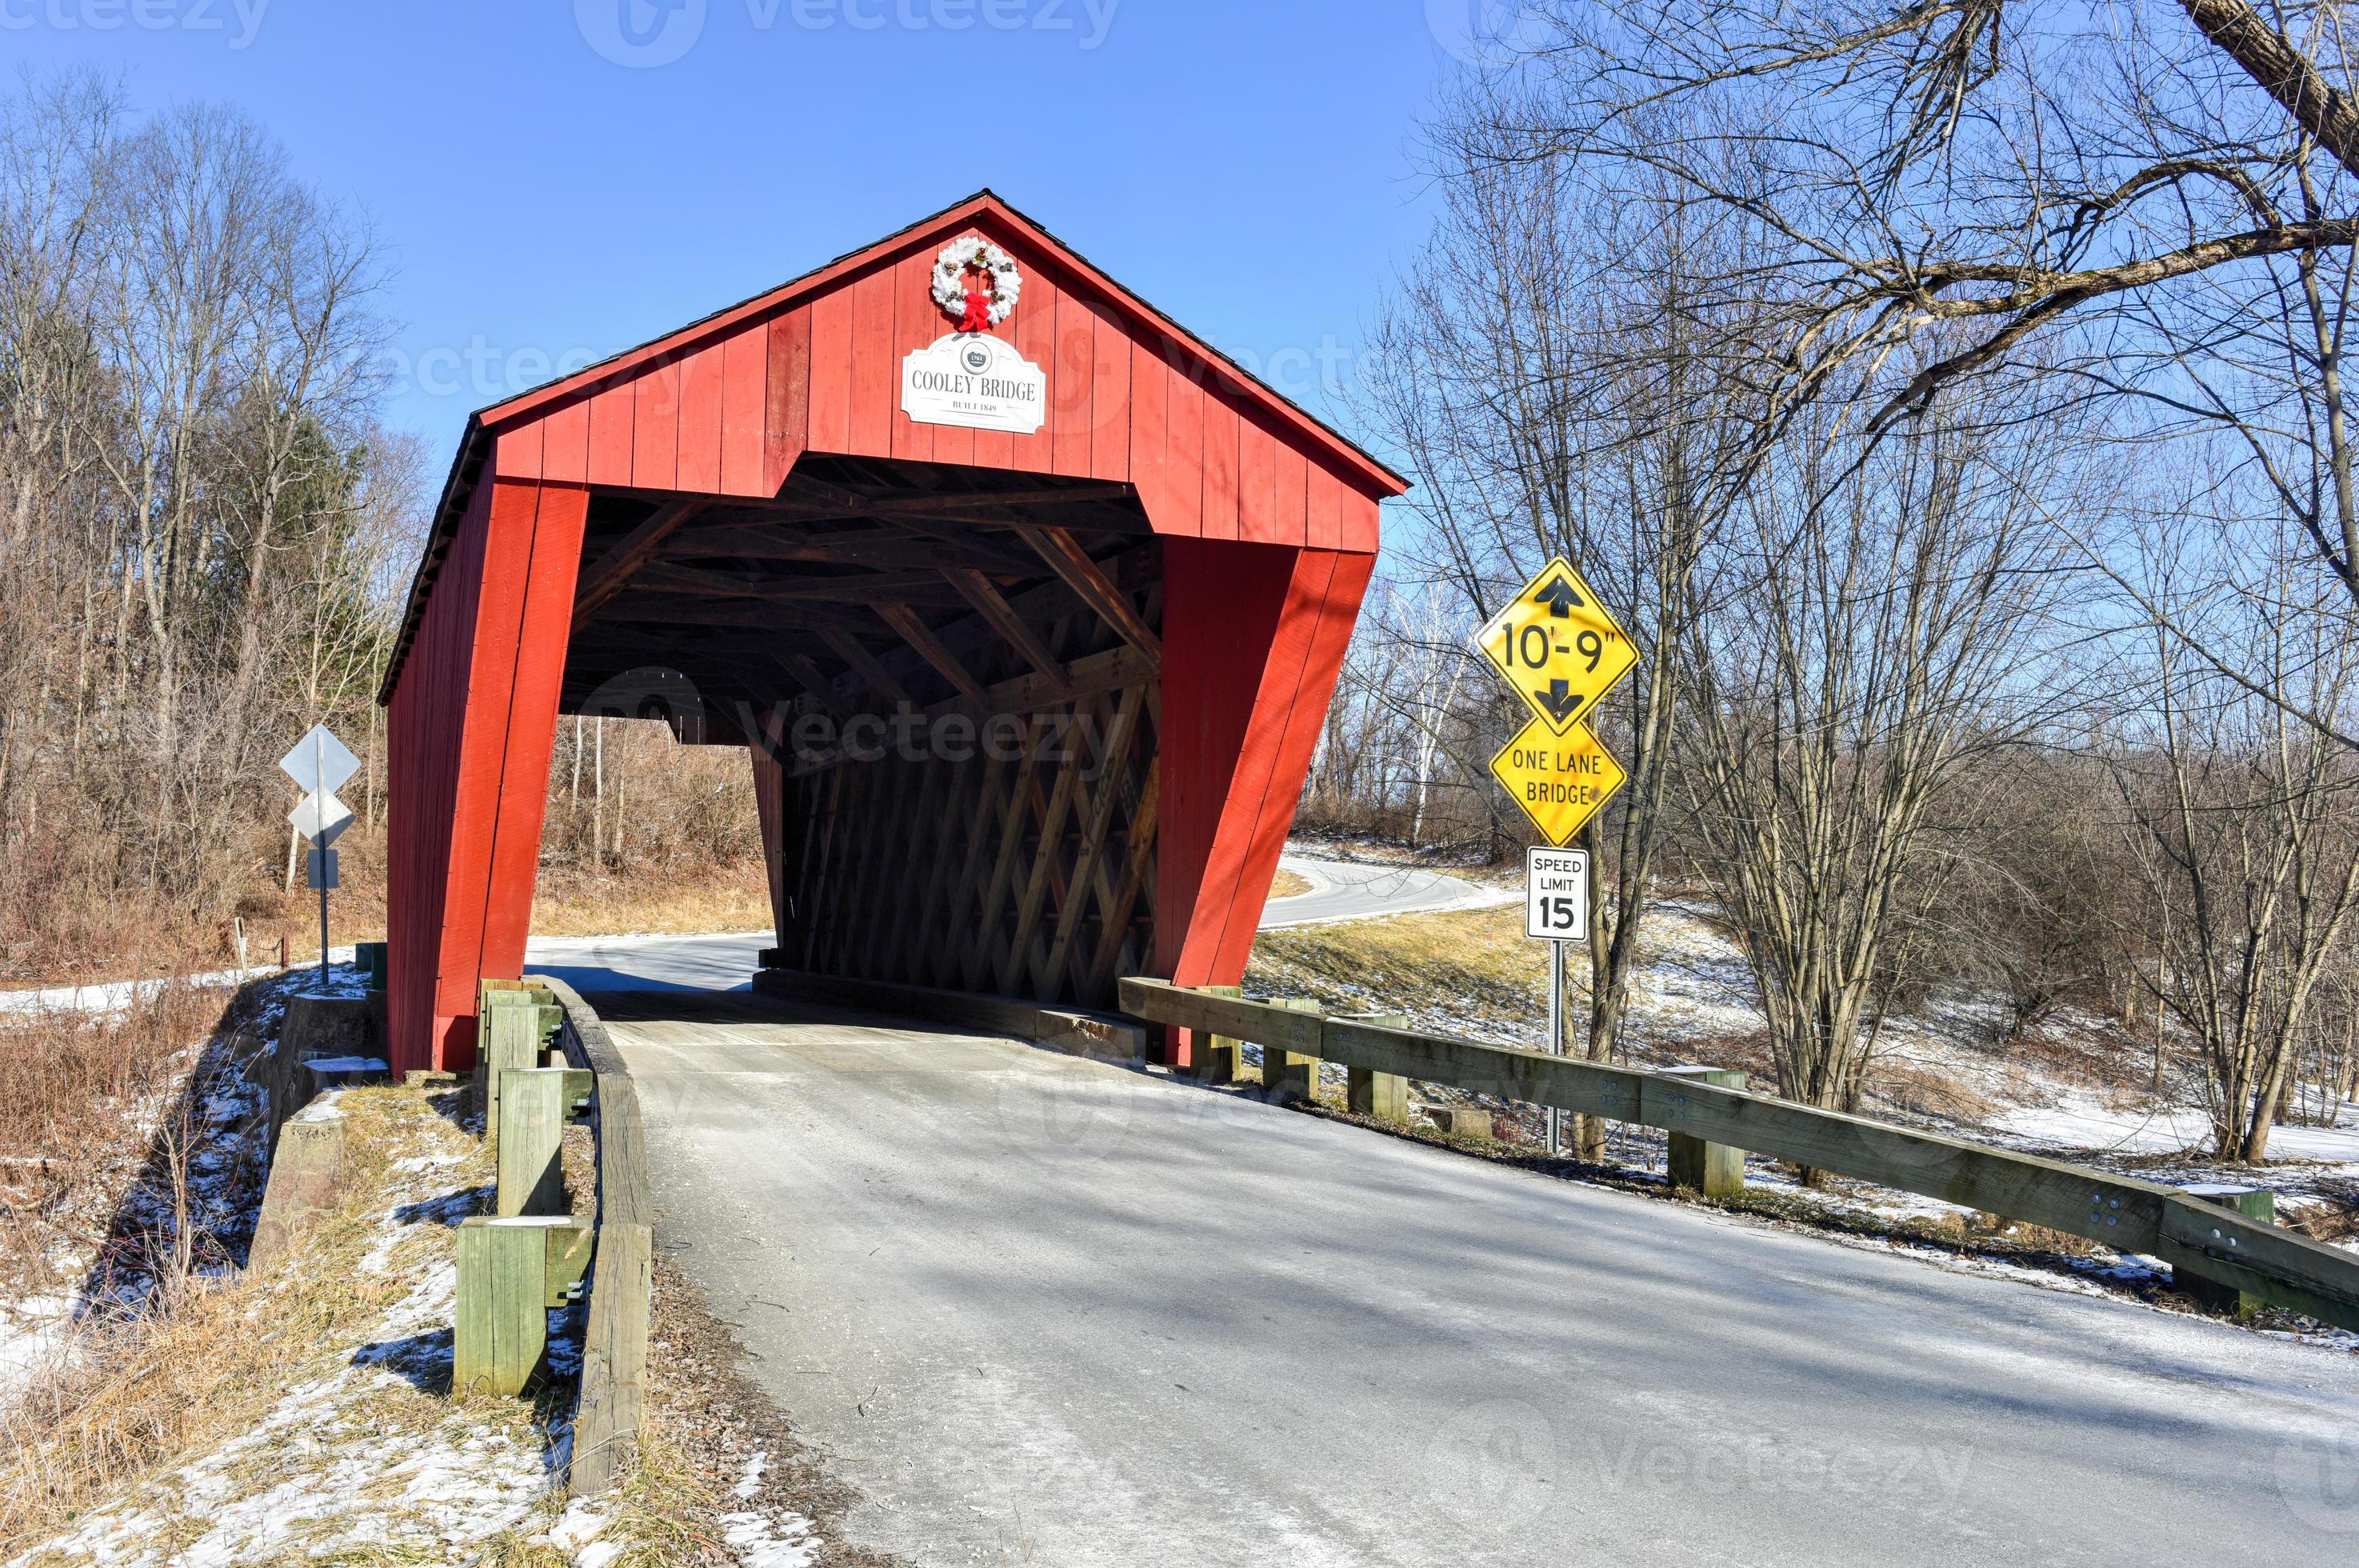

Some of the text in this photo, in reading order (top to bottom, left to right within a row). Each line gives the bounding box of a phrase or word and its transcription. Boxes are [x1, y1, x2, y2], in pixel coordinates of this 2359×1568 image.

[912, 370, 1035, 401] COOLEY BRIDGE
[953, 401, 997, 412] BUILT 1849
[1513, 749, 1601, 774] ONE LANE
[1527, 782, 1589, 806] BRIDGE
[1534, 858, 1581, 873] SPEED
[1541, 877, 1574, 891] LIMIT
[1540, 897, 1574, 930] 15
